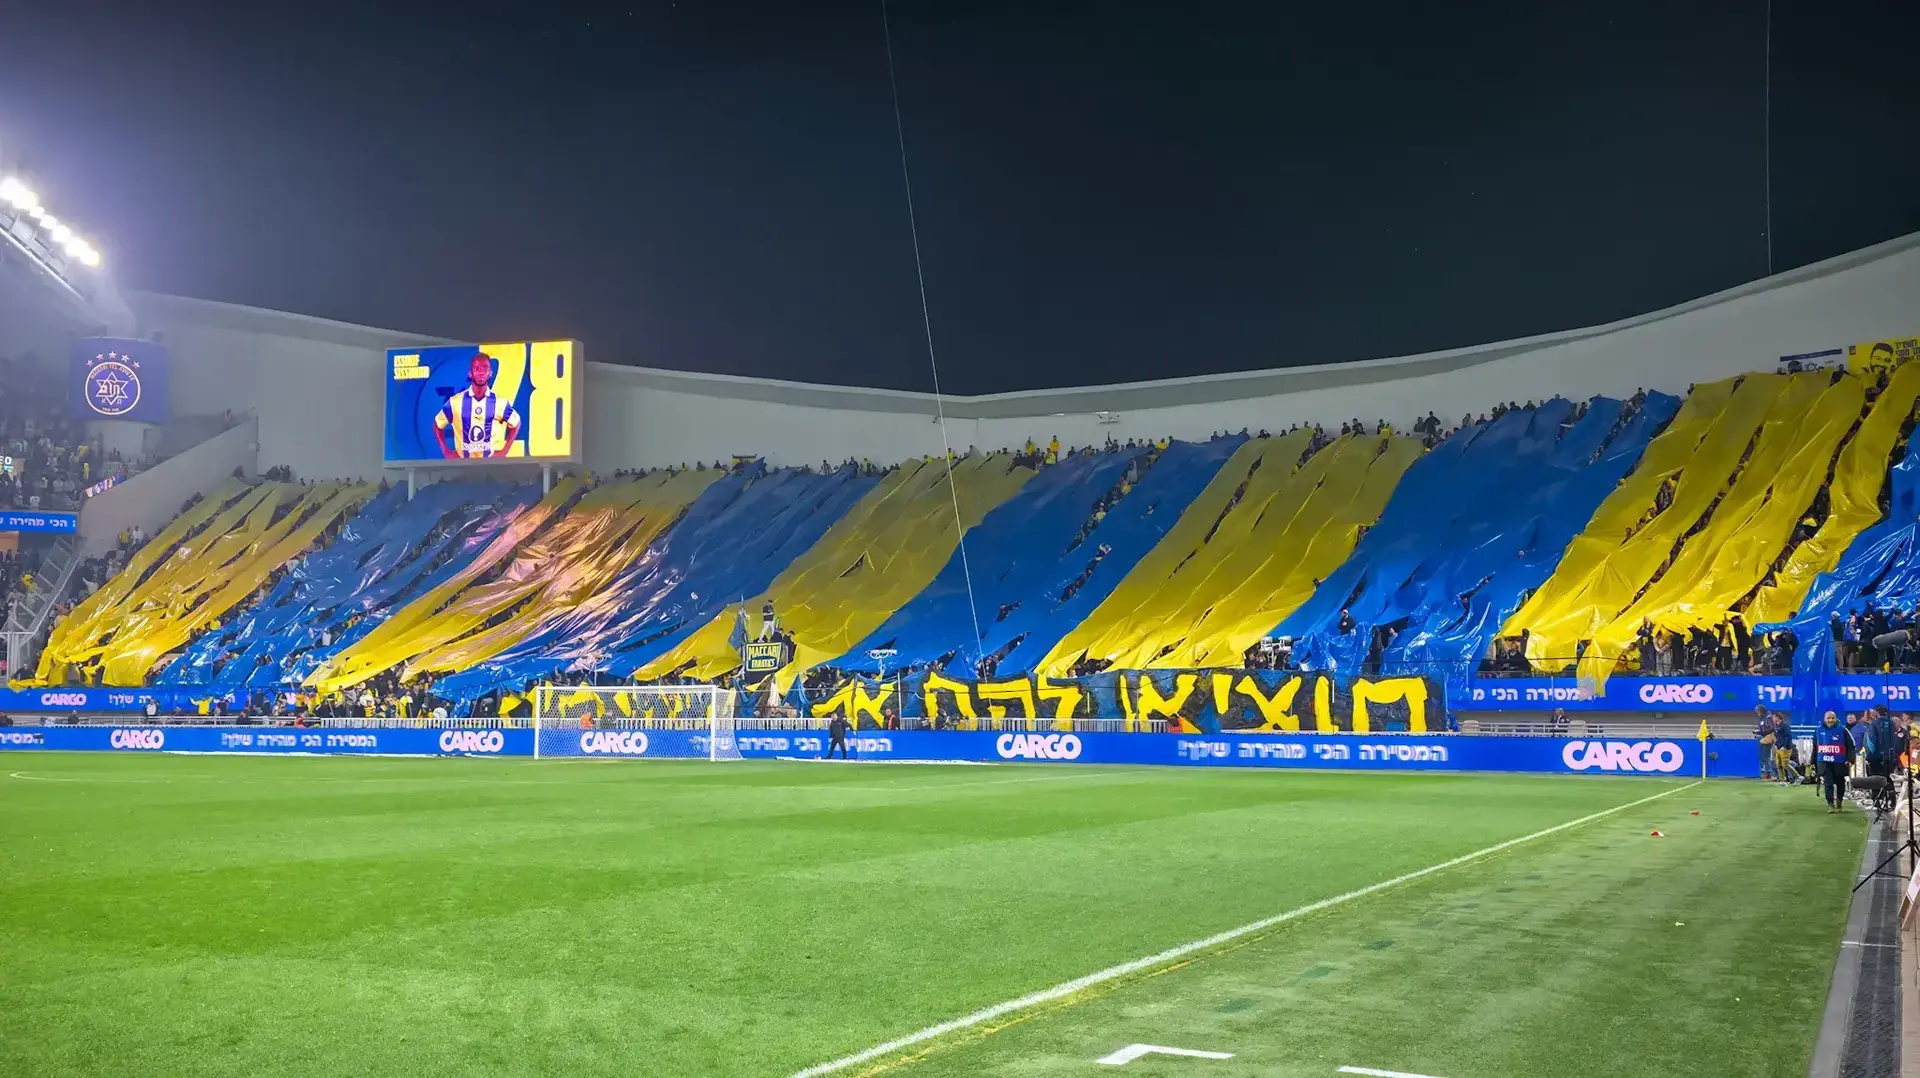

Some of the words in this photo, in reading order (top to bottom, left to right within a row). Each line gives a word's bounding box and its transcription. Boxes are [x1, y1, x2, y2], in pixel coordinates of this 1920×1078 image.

[479, 341, 572, 457] 28
[10, 517, 45, 526] מהירה
[49, 519, 67, 527] הכי
[41, 693, 87, 706] CARGO
[1492, 686, 1518, 700] הכי
[1639, 683, 1714, 703] CARGO
[1882, 685, 1911, 699] הכי
[109, 694, 134, 709] שלך!
[110, 729, 164, 749] CARGO
[221, 732, 253, 748] שלך!
[256, 734, 297, 747] מהירה
[301, 734, 322, 747] הכי
[326, 734, 377, 747] המסירה
[439, 730, 504, 752] CARGO
[580, 731, 648, 753] CARGO
[739, 737, 791, 751] מהירה
[793, 738, 822, 751] הכי
[997, 733, 1082, 759] CARGO
[1178, 740, 1231, 760] שלך!
[1238, 742, 1306, 759] מהירה
[1313, 743, 1350, 760] הכי
[1358, 744, 1448, 762] המסירה
[1562, 741, 1684, 772] CARGO
[1818, 745, 1840, 754] PHOTO
